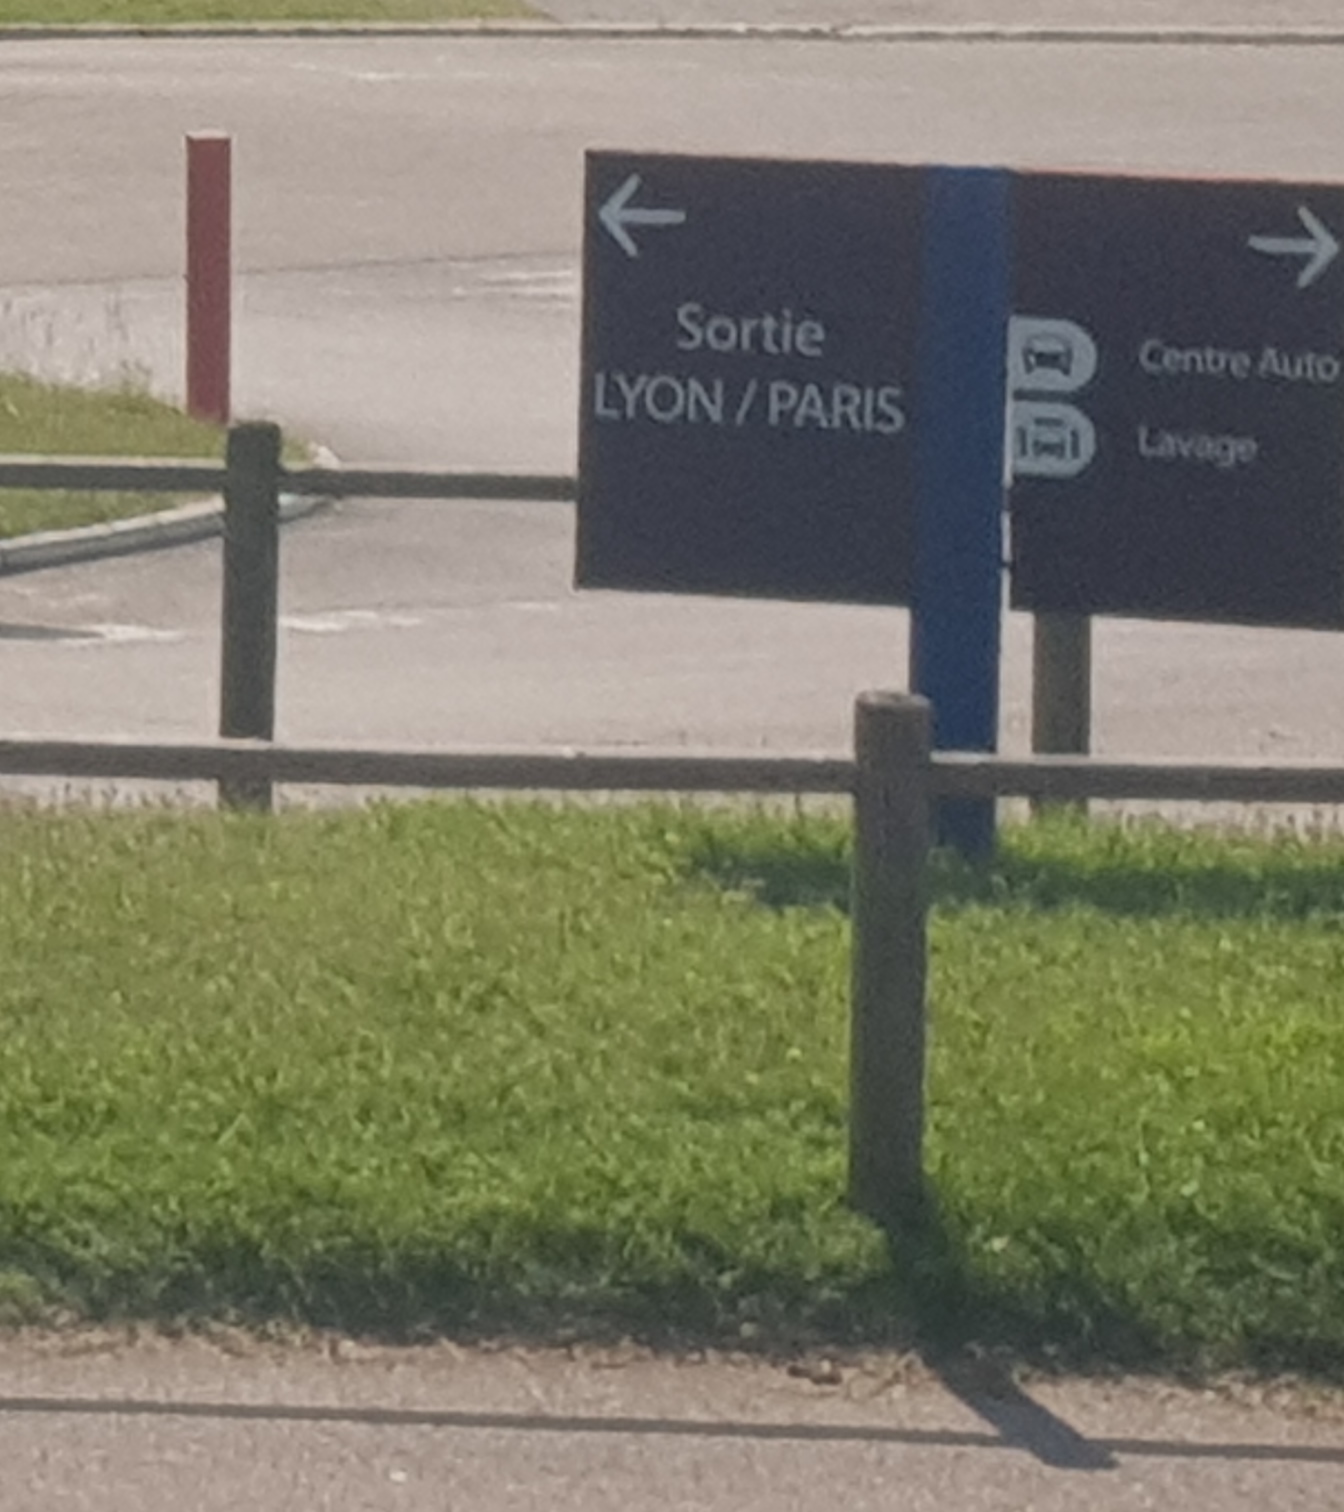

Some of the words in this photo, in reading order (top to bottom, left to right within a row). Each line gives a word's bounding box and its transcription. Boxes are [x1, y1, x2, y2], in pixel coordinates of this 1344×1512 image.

[676, 302, 826, 356] Sortie
[1138, 339, 1252, 379] Centre
[1258, 346, 1341, 383] Auto
[594, 372, 723, 424] LYON
[768, 381, 906, 434] PARIS
[1137, 425, 1259, 468] Lavage
